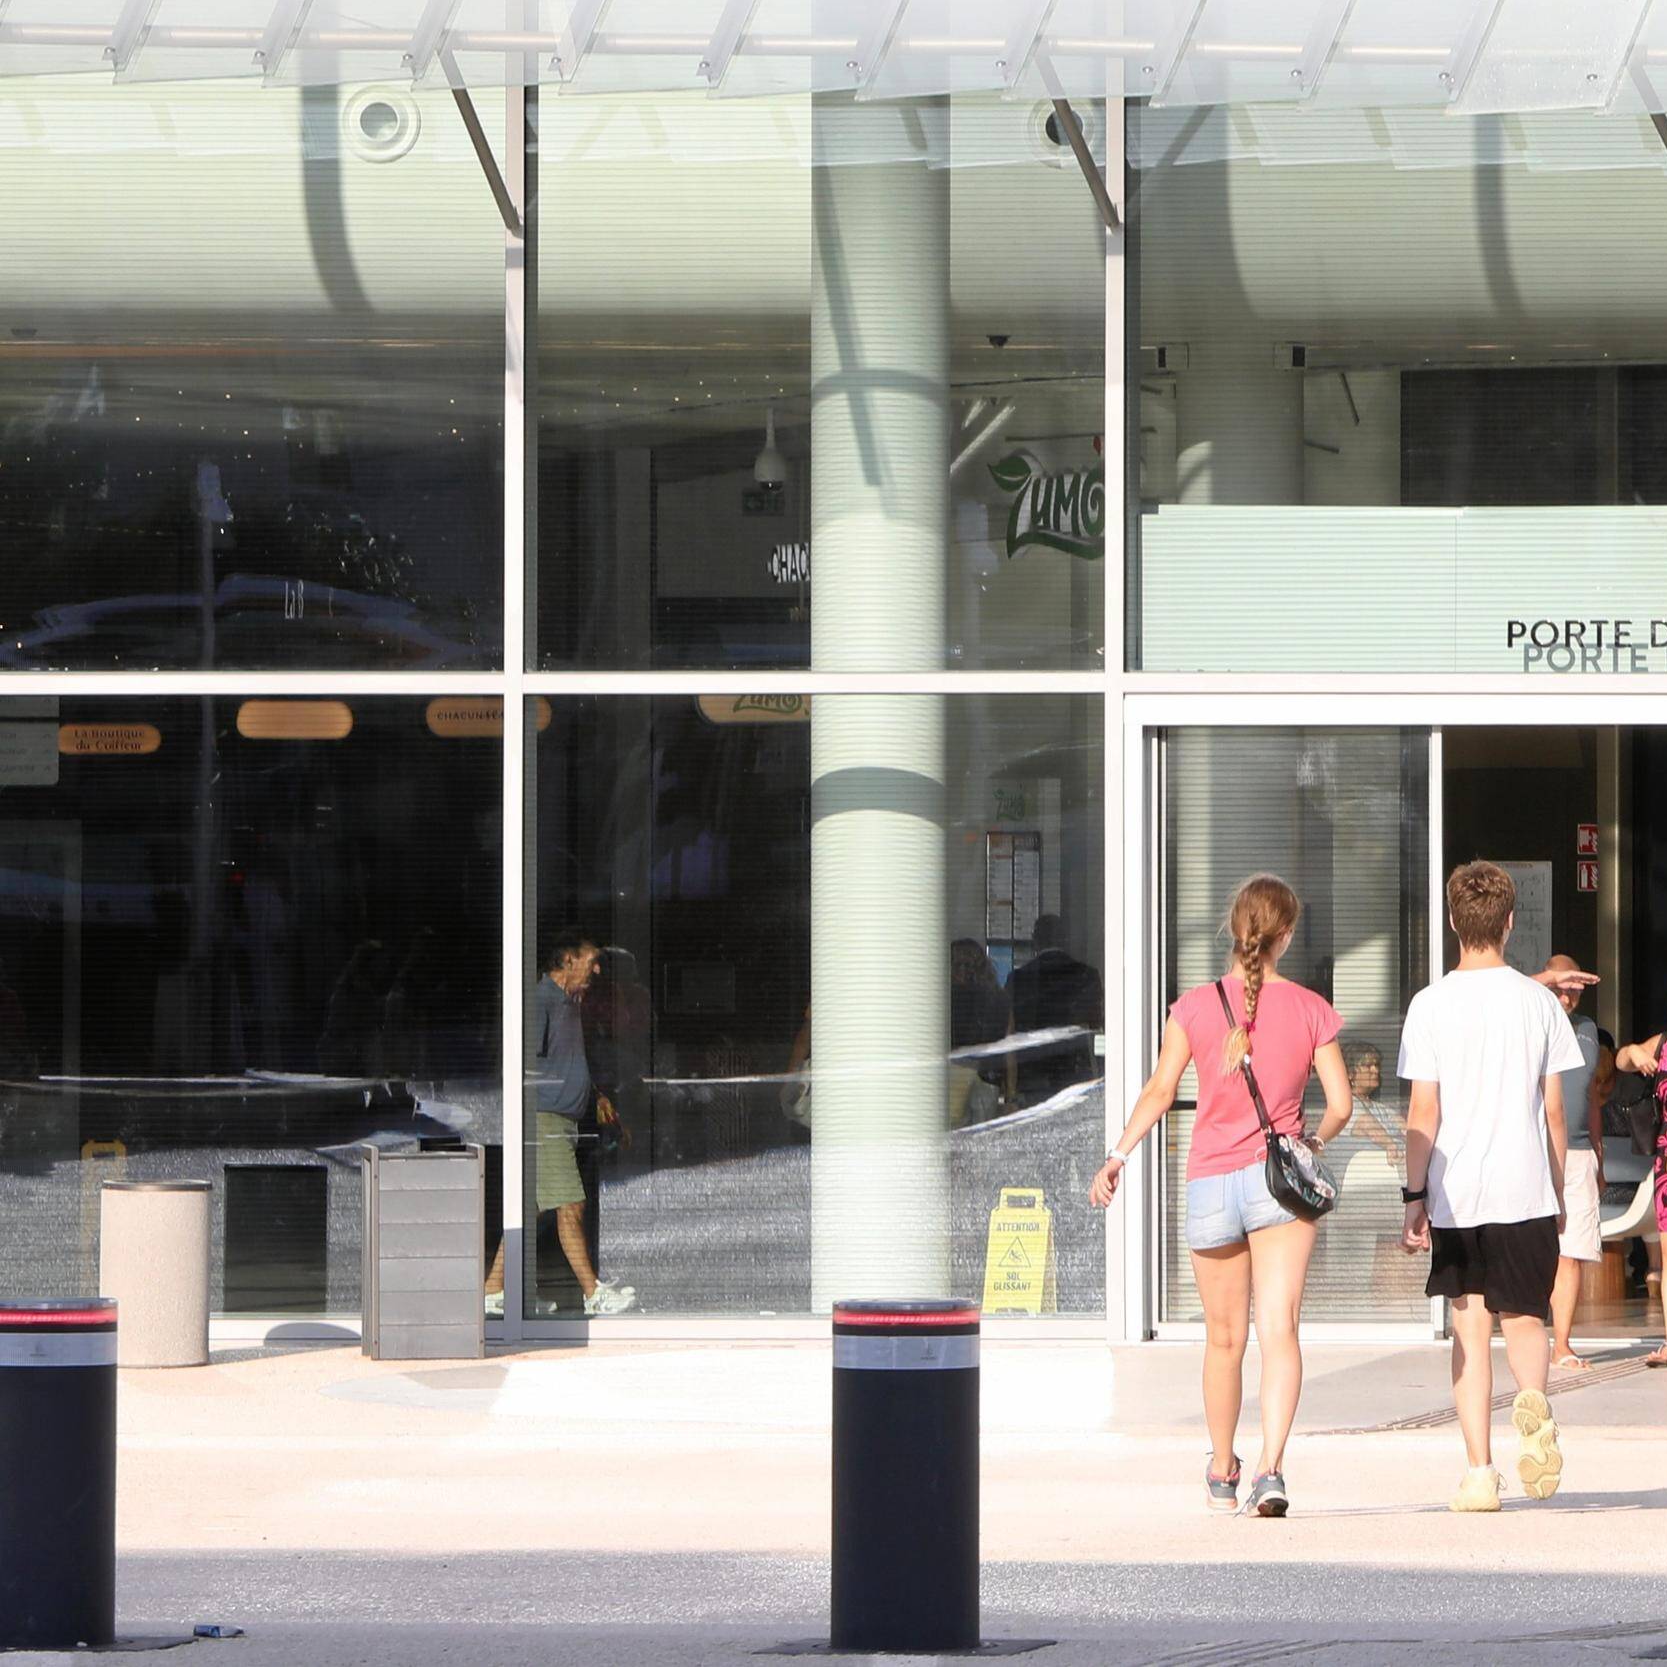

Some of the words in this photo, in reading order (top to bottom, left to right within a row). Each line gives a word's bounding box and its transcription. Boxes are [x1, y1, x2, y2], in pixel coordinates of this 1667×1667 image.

[1507, 620, 1632, 648] PORTE
[996, 1221, 1040, 1232] ATTENTION
[1006, 1270, 1021, 1281] SOL
[993, 1281, 1031, 1292] GLISSANT
